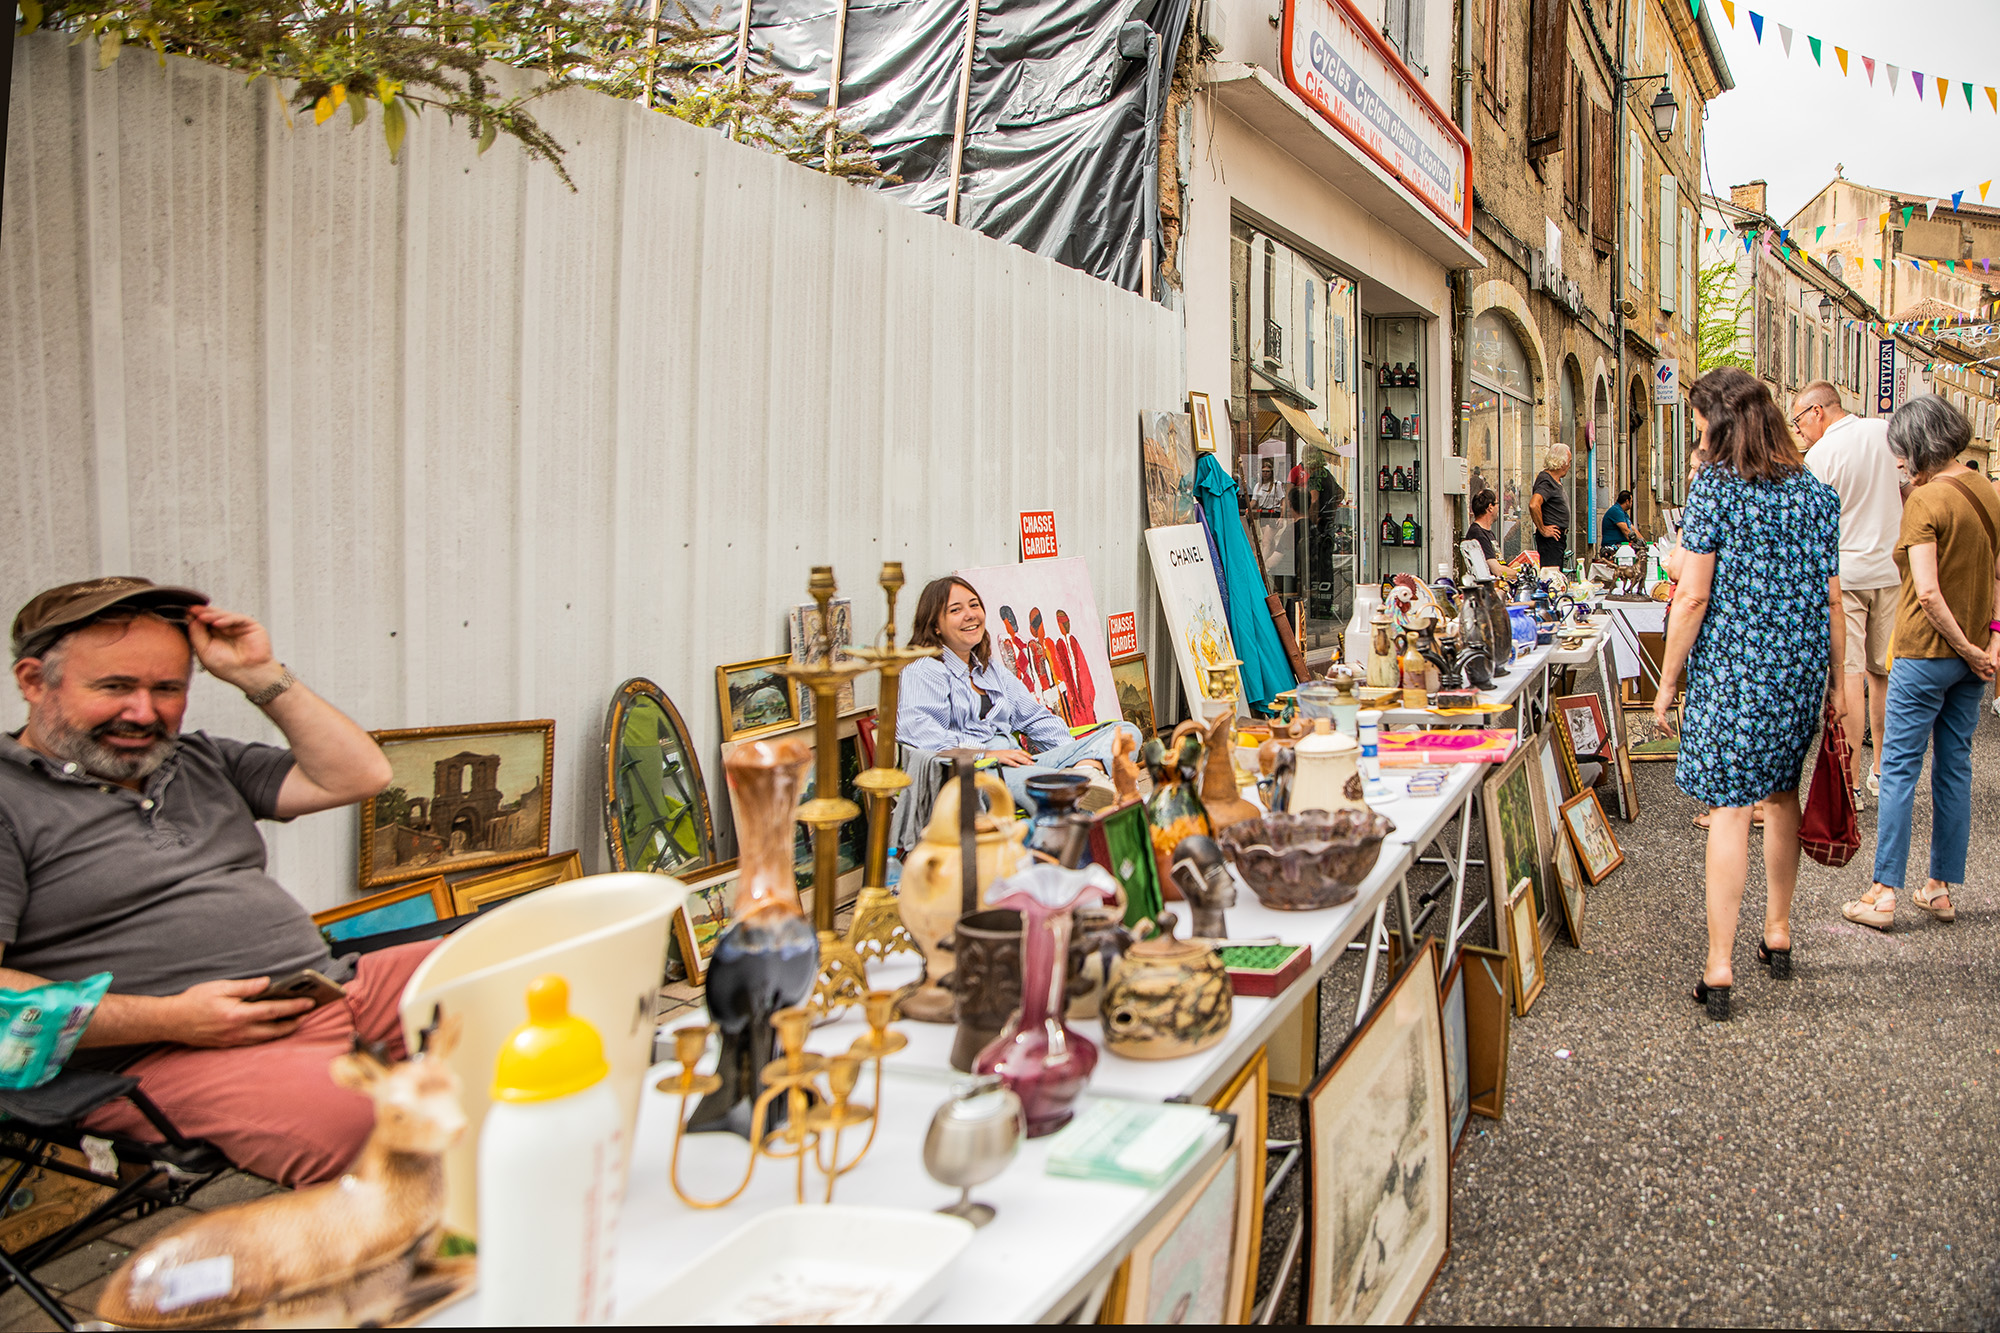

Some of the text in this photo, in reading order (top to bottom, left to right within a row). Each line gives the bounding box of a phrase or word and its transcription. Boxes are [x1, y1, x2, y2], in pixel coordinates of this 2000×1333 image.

[1306, 71, 1329, 109] Clés
[1334, 96, 1365, 138] Minute
[1313, 37, 1351, 93] Cycles
[1419, 143, 1450, 189] Scooters
[1880, 343, 1893, 397] CITIZEN
[1023, 515, 1053, 534] CHASSE
[1025, 534, 1055, 555] GARDÉE
[1170, 546, 1204, 567] CHANEL
[1110, 615, 1133, 634] CHASSE
[1112, 632, 1135, 653] GARDÉE
